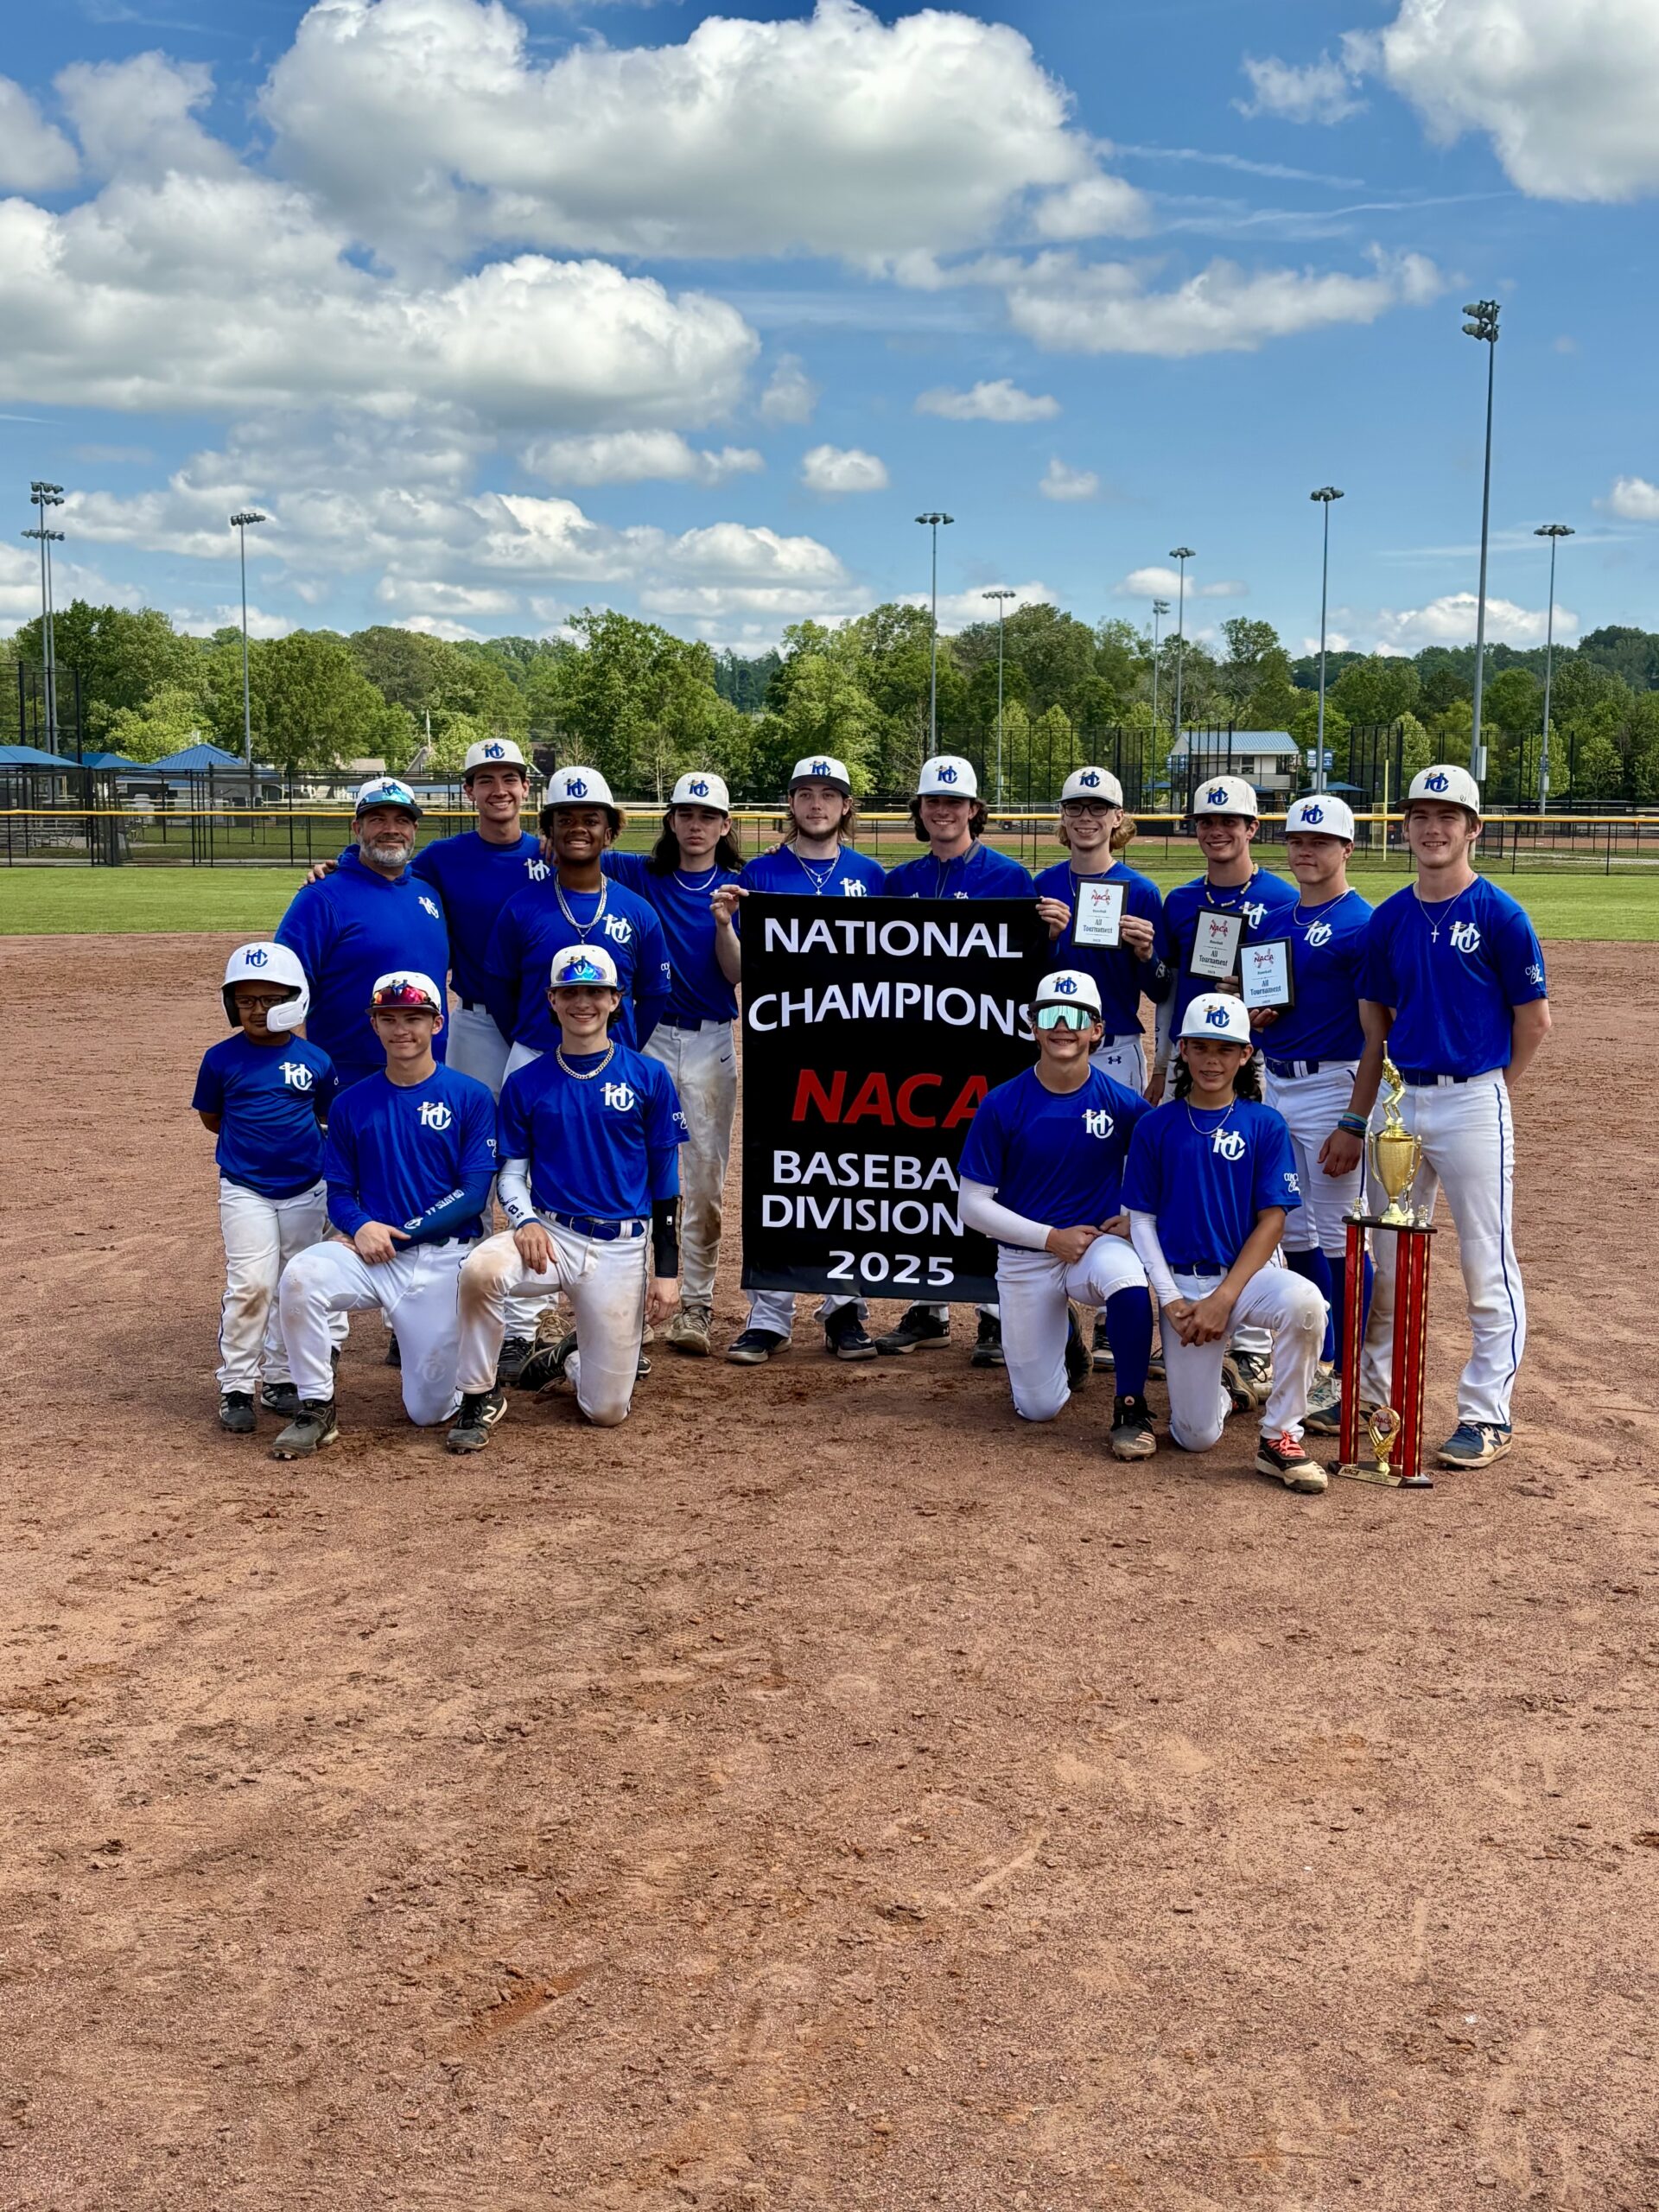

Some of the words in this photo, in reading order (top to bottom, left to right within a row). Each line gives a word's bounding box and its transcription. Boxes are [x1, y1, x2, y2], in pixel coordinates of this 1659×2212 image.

[765, 918, 1023, 959] NATIONAL
[1083, 925, 1113, 934] Tournament
[1210, 924, 1229, 933] NACA
[1198, 954, 1229, 967] Tournament
[1254, 954, 1274, 963] NACA
[1250, 985, 1281, 996] Tournament
[748, 982, 1036, 1041] CHAMPIONS
[791, 1069, 989, 1128] NACA
[773, 1150, 960, 1192] BASEBA
[762, 1194, 963, 1236] DIVISION
[826, 1250, 955, 1287] 2025
